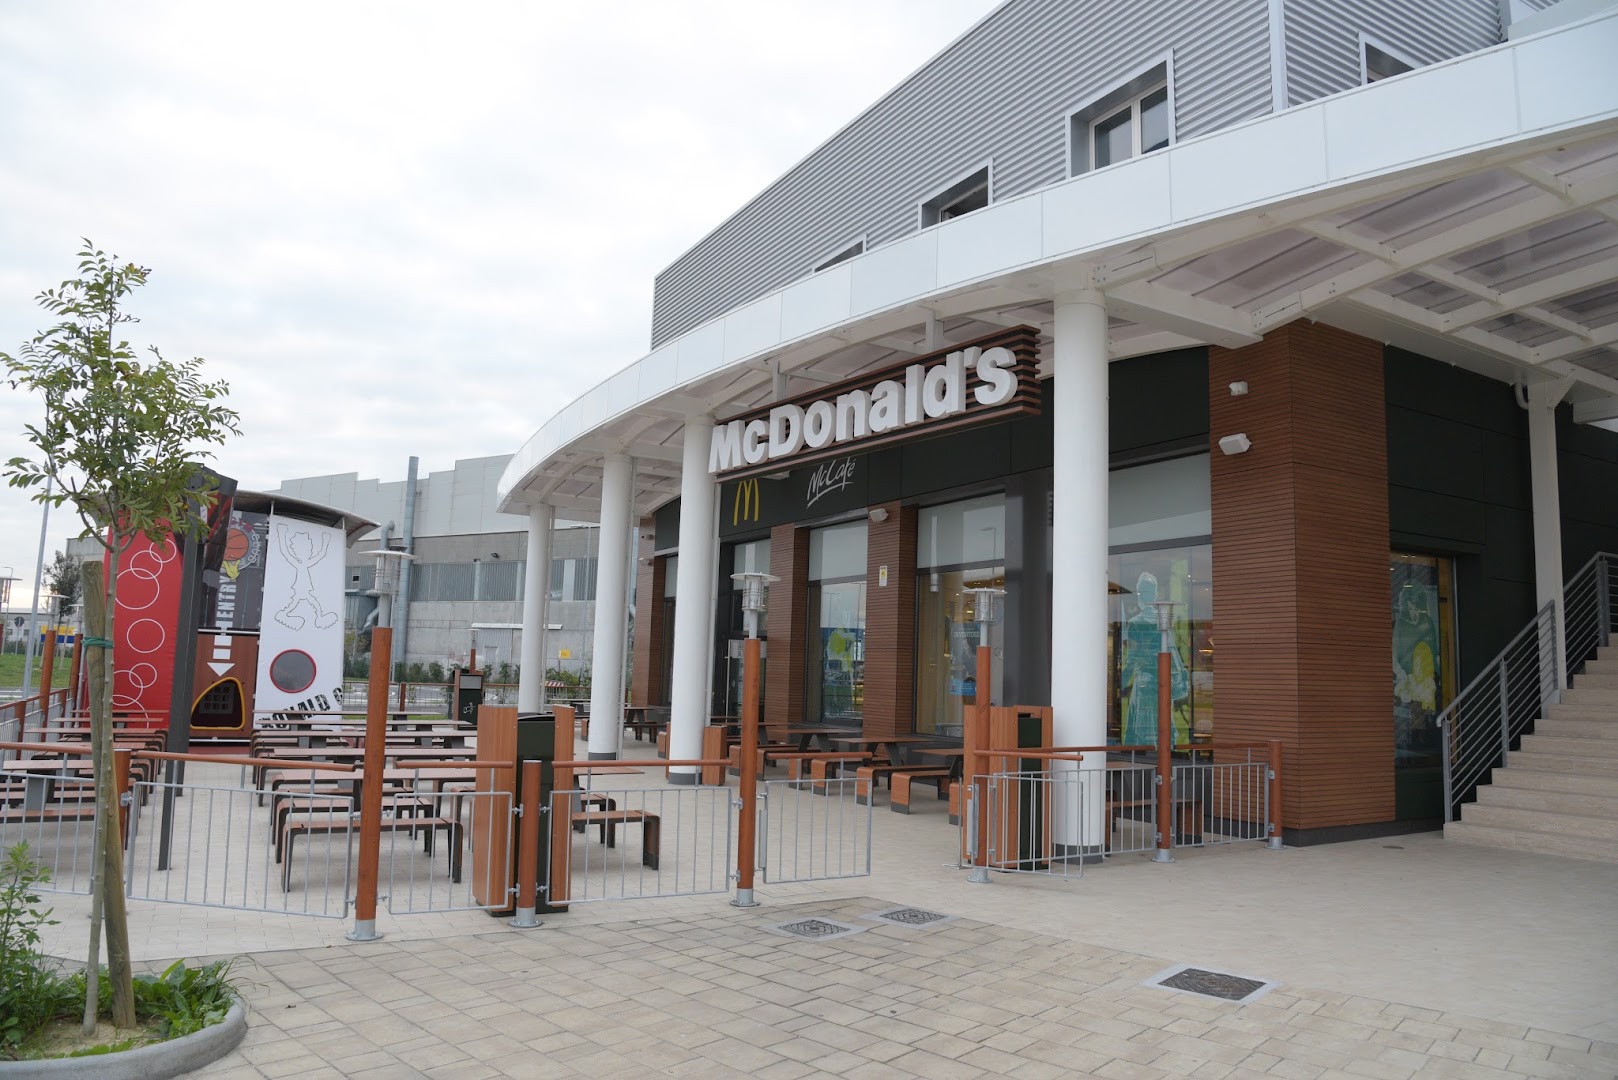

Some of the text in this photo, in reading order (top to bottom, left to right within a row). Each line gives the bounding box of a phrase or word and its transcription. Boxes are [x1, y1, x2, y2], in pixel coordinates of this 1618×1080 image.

[709, 346, 1018, 474] McDonald's
[807, 456, 856, 502] McCafé
[216, 575, 237, 619] ENTRY
